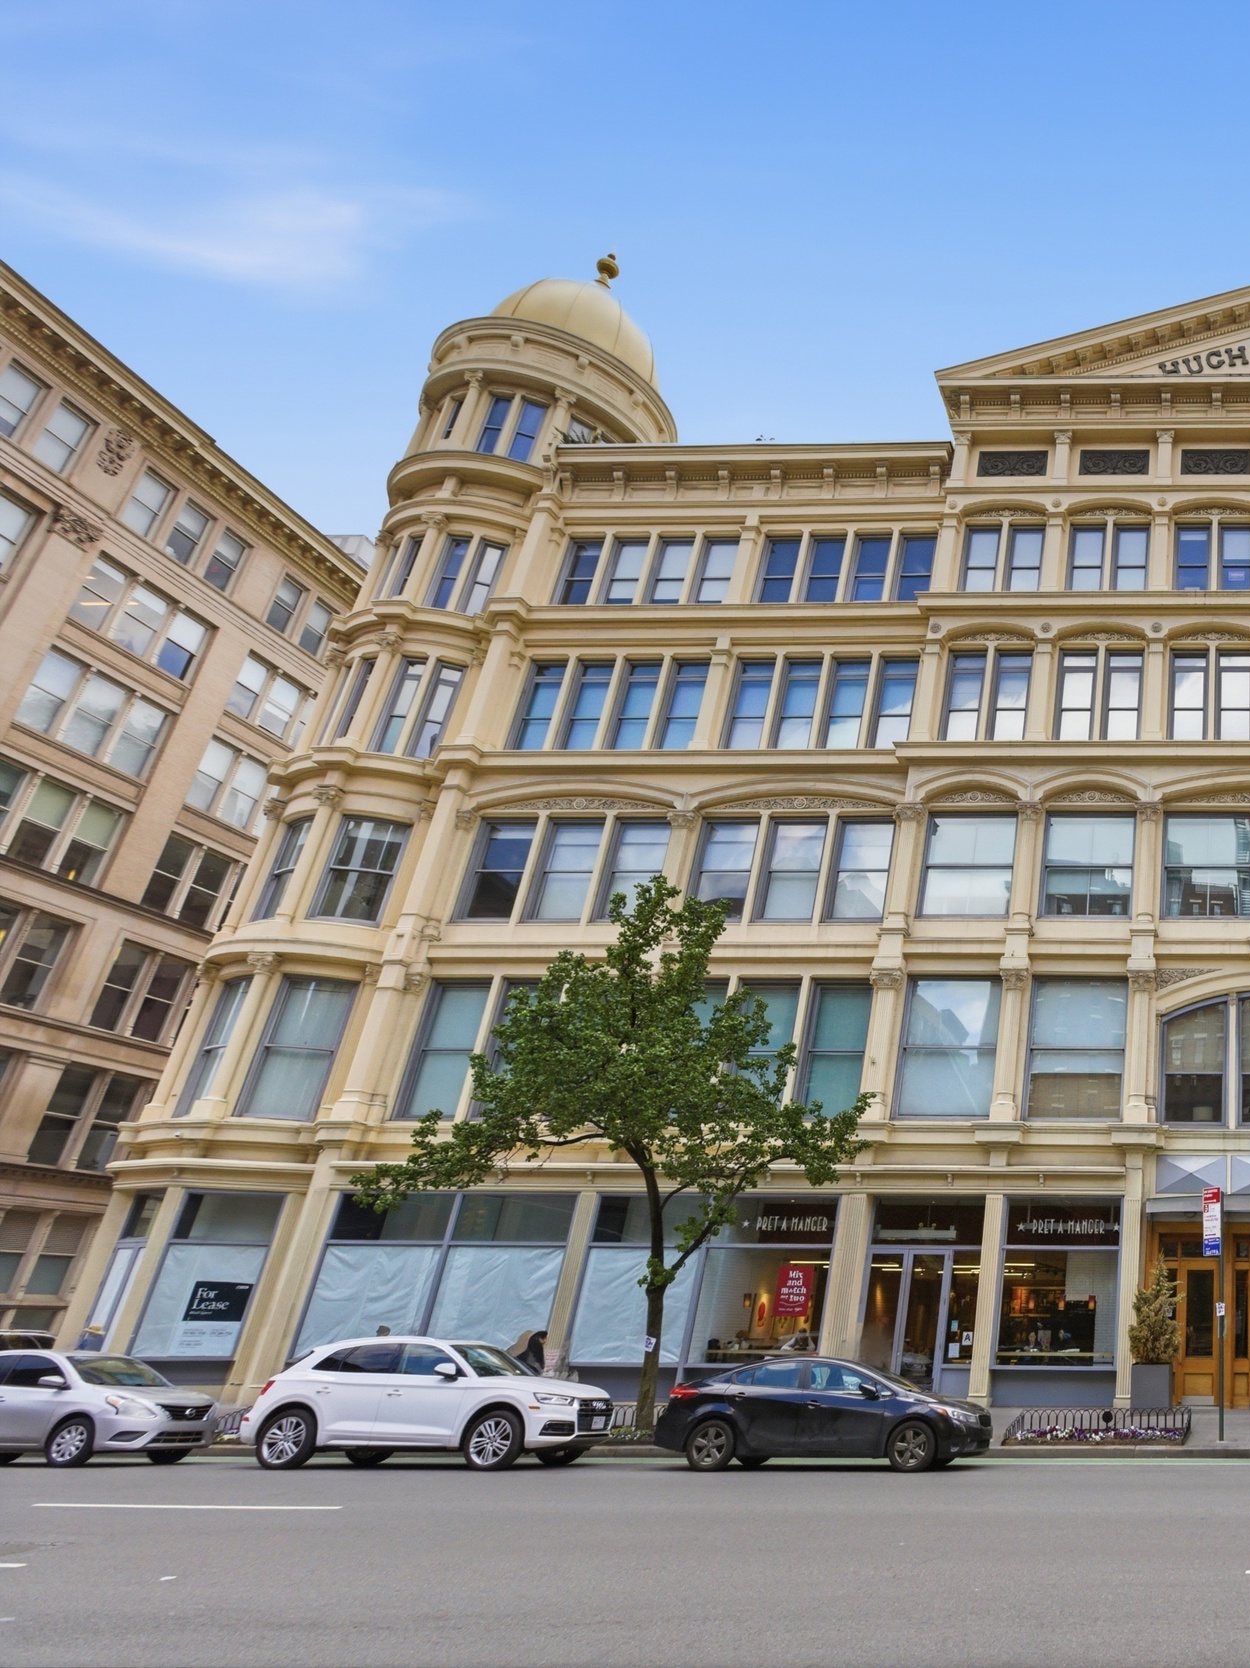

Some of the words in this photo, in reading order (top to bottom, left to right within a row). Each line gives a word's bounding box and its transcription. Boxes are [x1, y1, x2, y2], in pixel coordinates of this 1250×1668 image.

[1158, 345, 1250, 375] HUGH
[756, 1216, 780, 1231] PRET
[781, 1216, 787, 1231] A
[790, 1216, 828, 1231] MANGER
[1032, 1219, 1055, 1234] PRET
[1057, 1219, 1064, 1234] A
[1067, 1219, 1105, 1234] MANGER
[789, 1270, 803, 1279] Mix
[196, 1287, 219, 1299] For
[191, 1298, 230, 1310] Lease
[963, 1333, 971, 1342] A
